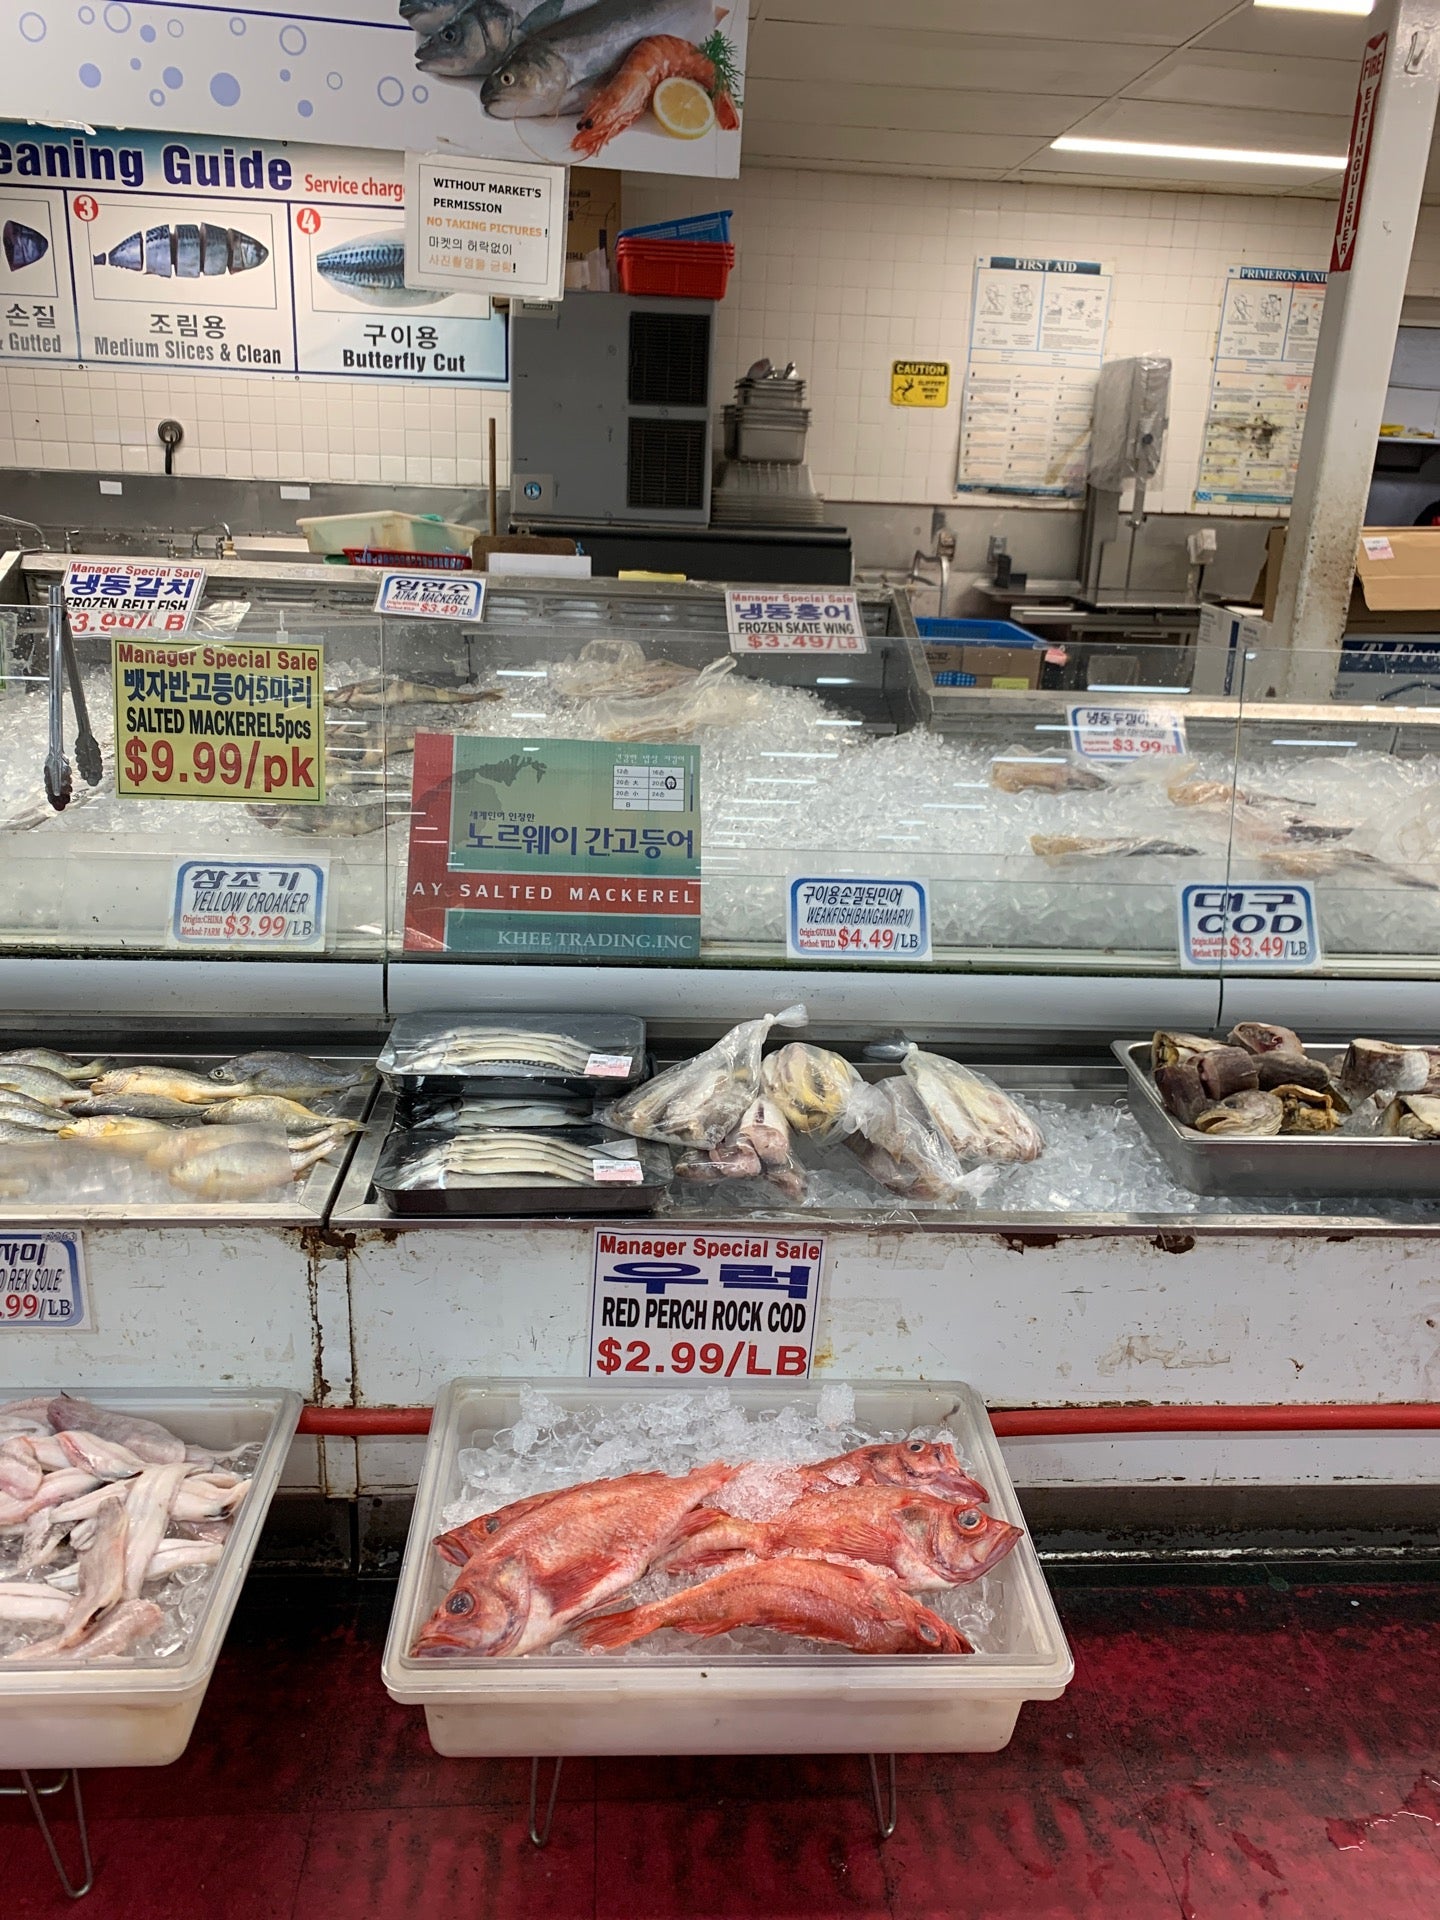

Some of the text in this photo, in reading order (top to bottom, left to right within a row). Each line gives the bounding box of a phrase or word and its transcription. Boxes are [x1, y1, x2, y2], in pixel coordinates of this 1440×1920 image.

[1363, 52, 1382, 81] FIRE
[163, 144, 292, 191] Guide
[1339, 87, 1372, 256] EXTINGUISHER
[305, 174, 404, 202] Service charg
[433, 177, 541, 198] WITHOUT MARKET'S
[80, 198, 95, 218] 3
[433, 198, 502, 214] PERMISSION
[303, 209, 316, 233] 4
[426, 216, 442, 227] NO
[446, 218, 486, 231] TAKING
[490, 223, 542, 237] PICTURES
[429, 235, 512, 255] 마켓의 허락없이
[1015, 259, 1077, 273] FIRST AID
[1241, 268, 1296, 281] PRIMEROS
[5, 303, 56, 329] 손질
[149, 313, 226, 340] 조림용
[9, 332, 61, 353] Gutted
[363, 324, 438, 349] 구이용
[94, 336, 281, 365] Medium Slices & Clean
[343, 349, 465, 373] Butterfly Cut
[896, 364, 945, 375] CAUTION
[71, 563, 200, 578] Manager Special Sale
[69, 574, 195, 598] 냉동갈치
[395, 580, 470, 593] 임연수
[157, 600, 188, 611] FISH
[392, 590, 470, 606] ATKA MACKEREL
[732, 592, 854, 604] Manager Special Sale
[735, 603, 851, 621] 냉동홍어
[738, 622, 854, 634] FROZEN SKATE WING
[748, 634, 858, 649] $3.49/LB
[118, 644, 317, 671] Manager Special Sale
[126, 707, 312, 744] SALTED MACKEREL5pcs
[125, 736, 315, 792] $9.99/pk
[466, 823, 693, 859] 노르웨이 간고등어
[191, 869, 300, 891] 참조기
[192, 891, 309, 914] YELLOW CROAKER
[412, 882, 695, 904] AY SALTED MACKEREL
[803, 885, 903, 906] 구이용손질된민어
[1194, 893, 1296, 912] 대구
[223, 912, 312, 938] $3.99/LB
[806, 907, 914, 927] WEAKFISH(BANGAMARY)
[1197, 914, 1303, 934] COD
[203, 927, 221, 937] FARM
[498, 931, 693, 949] KHEE TRADING.INC
[837, 926, 919, 950] $4.49/LB
[820, 940, 836, 948] WILD
[1229, 934, 1308, 958] $3.49/LB
[600, 1235, 820, 1260] Manager Special Sale
[7, 1268, 31, 1291] REX
[32, 1268, 63, 1291] SOLE
[603, 1261, 811, 1299] 우럭
[602, 1296, 807, 1333] RED PERCH ROCK COD
[596, 1337, 807, 1378] $2.99/LB
